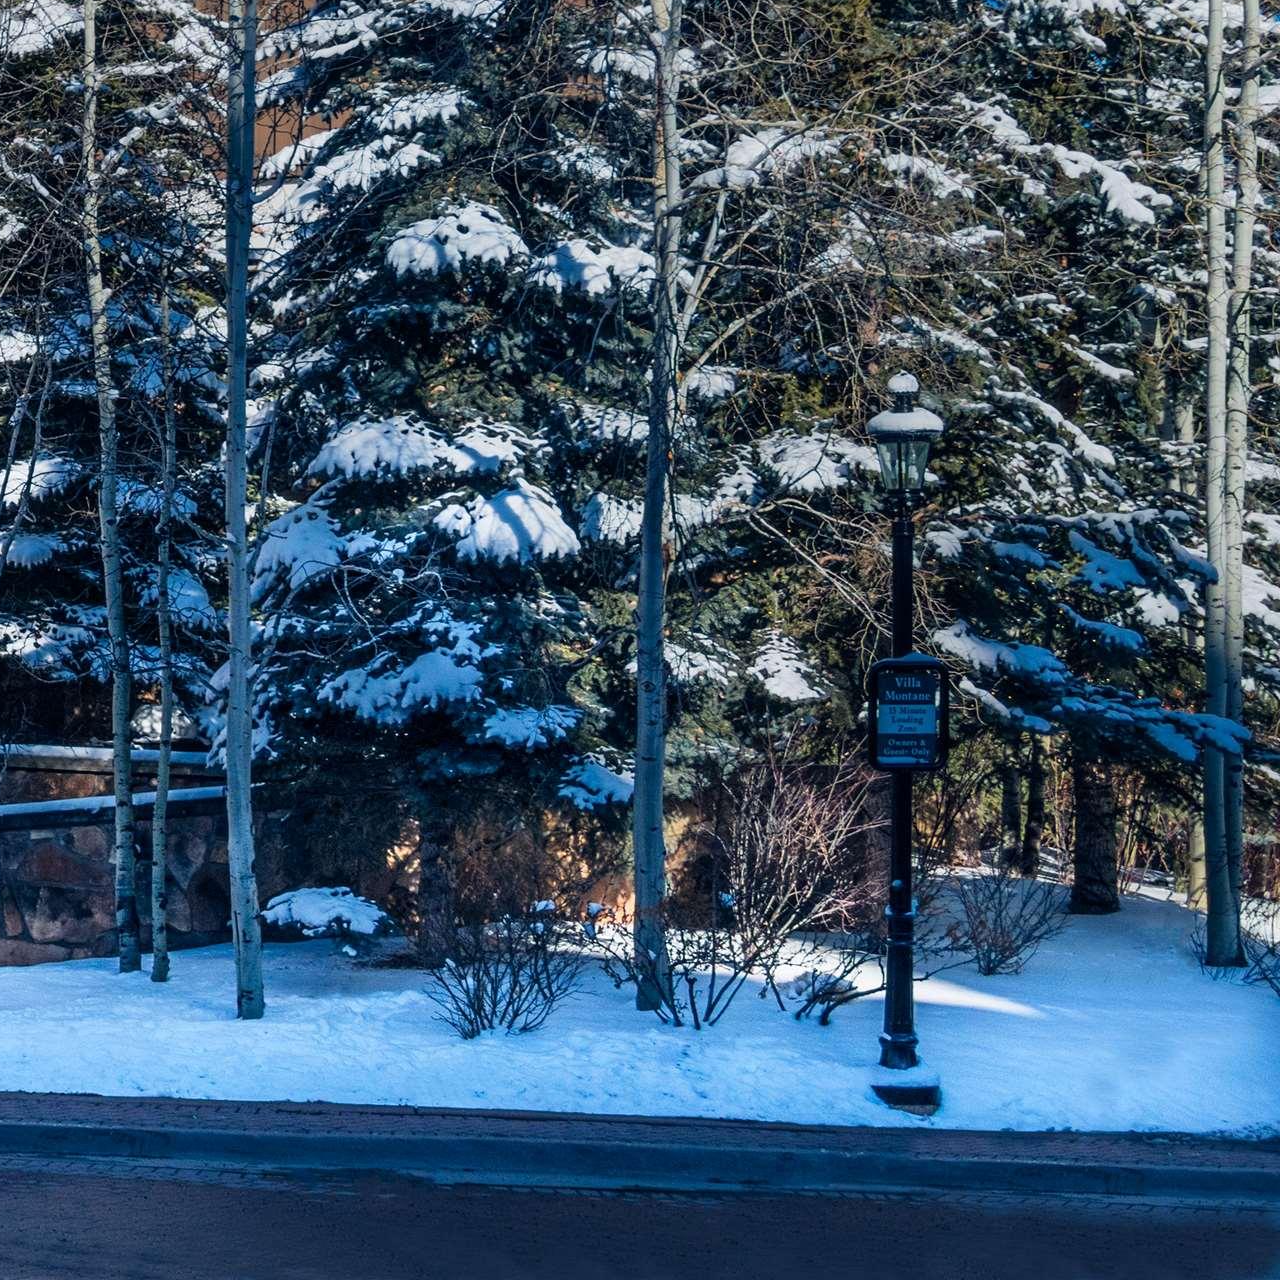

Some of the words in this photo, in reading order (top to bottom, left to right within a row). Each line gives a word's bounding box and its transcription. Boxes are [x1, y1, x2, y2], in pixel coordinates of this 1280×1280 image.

[895, 677, 921, 688] Villa
[885, 691, 931, 701] Montane
[911, 747, 929, 758] Only
